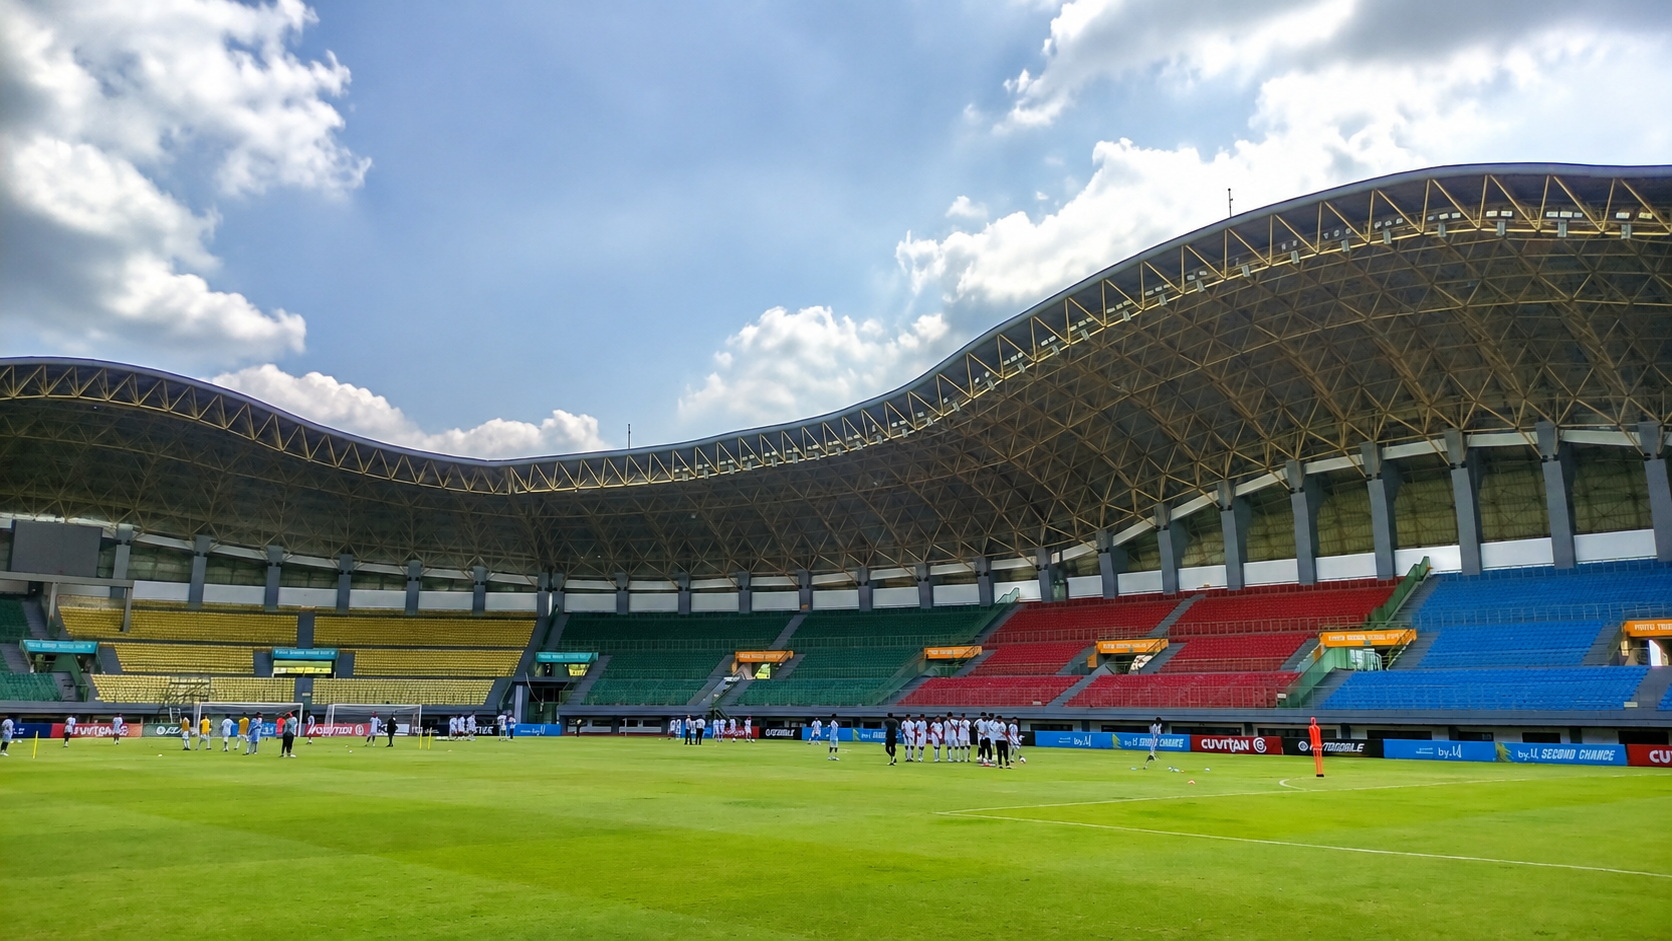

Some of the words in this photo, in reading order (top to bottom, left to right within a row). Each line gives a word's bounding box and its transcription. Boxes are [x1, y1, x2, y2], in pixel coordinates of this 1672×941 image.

[1201, 738, 1249, 752] CUVITAN
[1541, 748, 1576, 760] SECOND
[1579, 749, 1616, 761] CHANCE
[1649, 749, 1672, 763] CU
